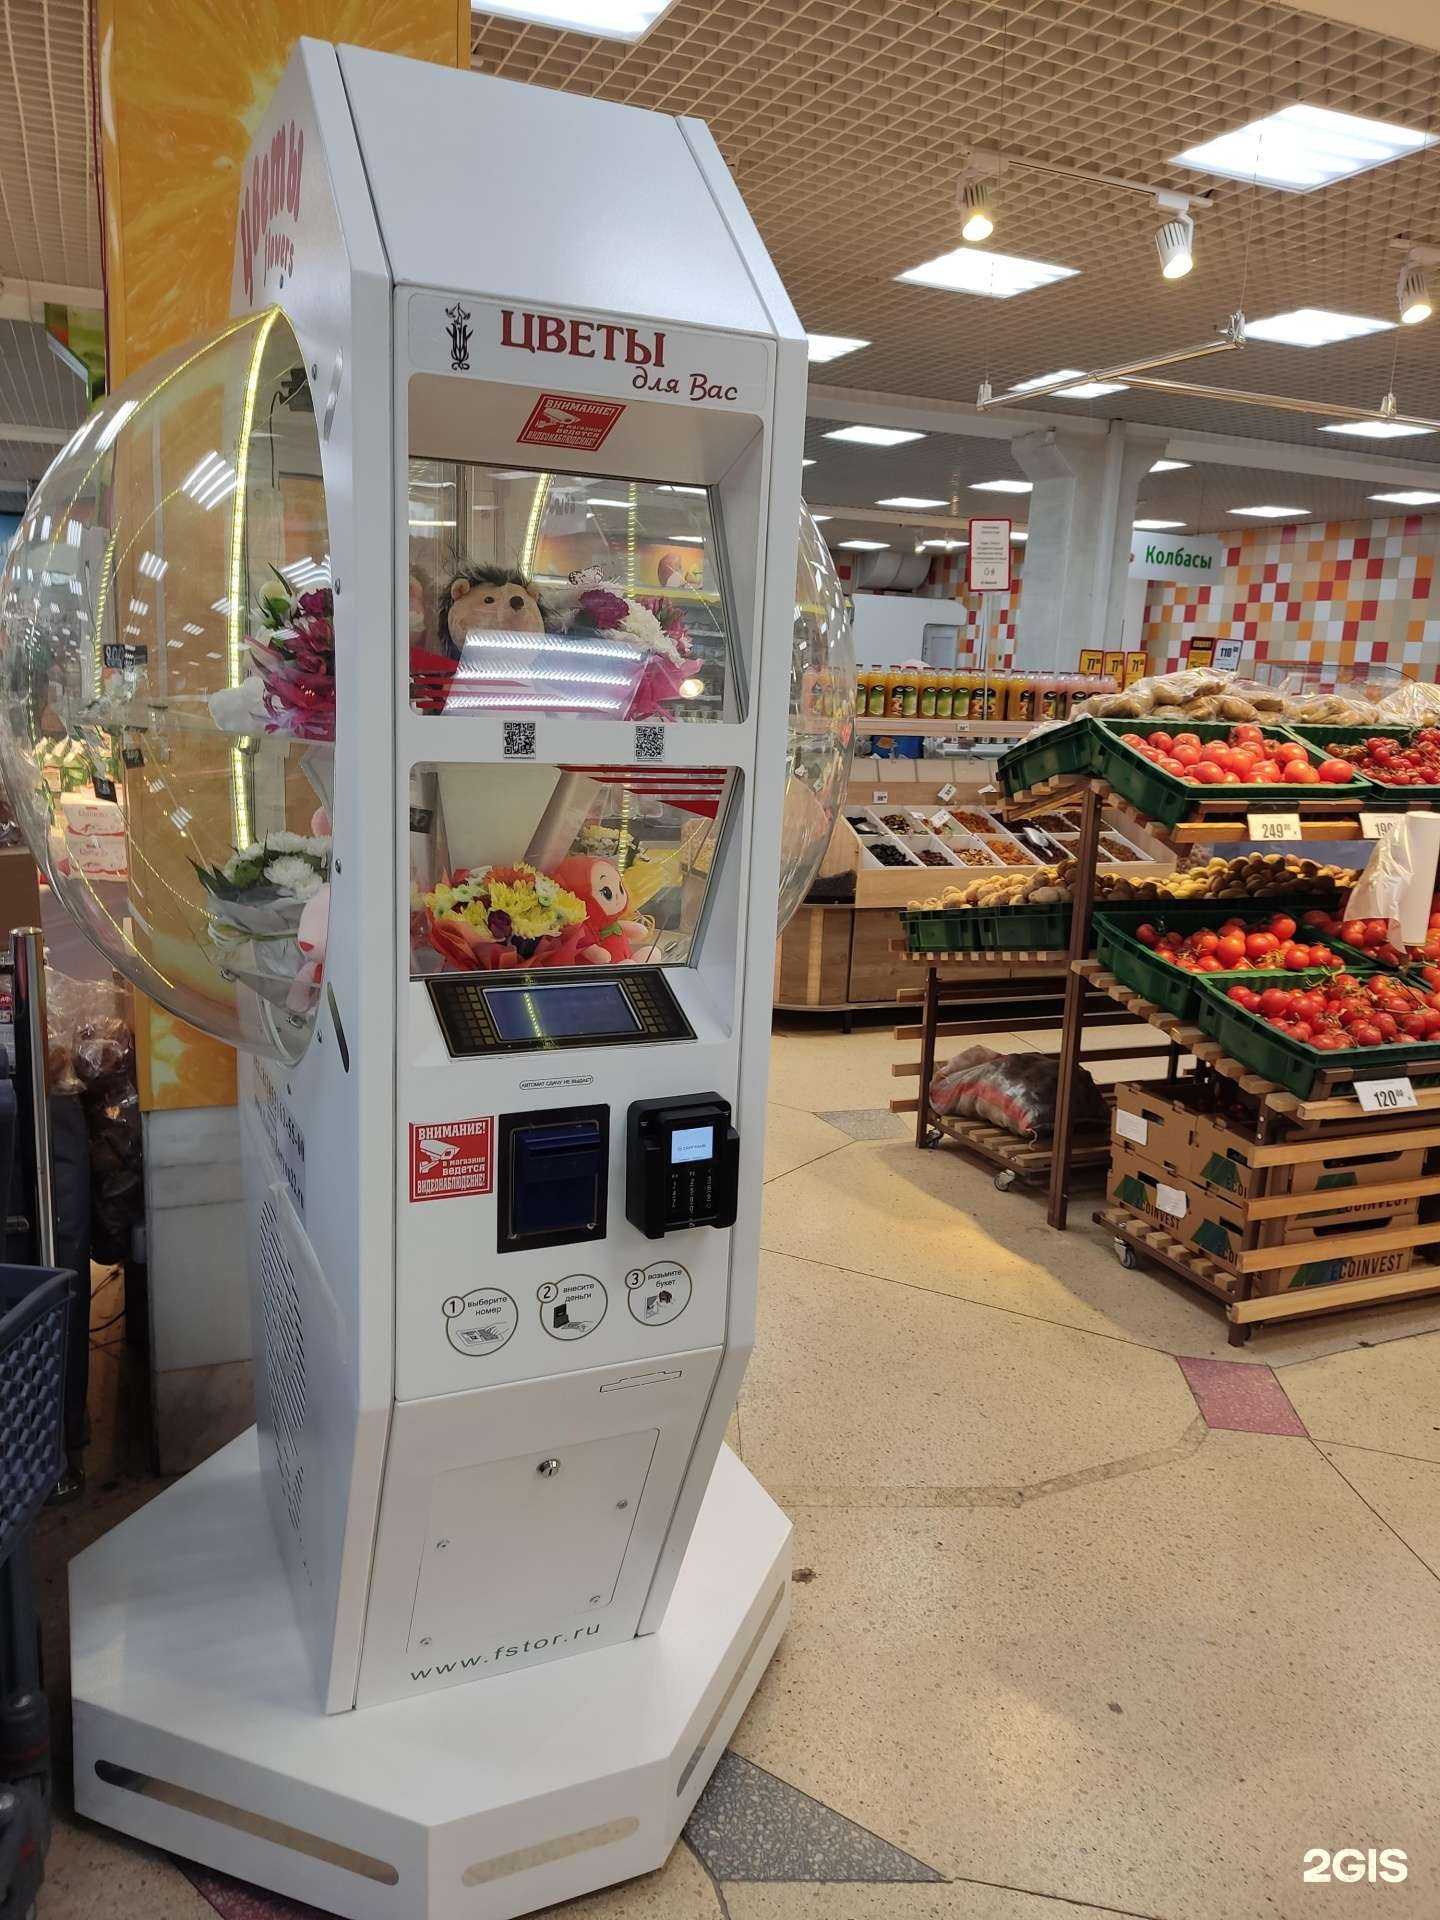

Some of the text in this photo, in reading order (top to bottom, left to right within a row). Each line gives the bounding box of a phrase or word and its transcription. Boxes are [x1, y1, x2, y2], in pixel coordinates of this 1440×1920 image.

[500, 309, 666, 367] ЦВЕТЫ
[632, 365, 738, 401] для Вас
[544, 399, 615, 416] ВНИМАНИЕ!
[1145, 545, 1212, 569] Колбасы
[1374, 1089, 1397, 1108] 120
[418, 1121, 486, 1140] ВНИМАНИЕ!
[449, 1157, 486, 1166] магазине
[442, 1164, 486, 1176] ведется
[417, 1174, 486, 1195] ВИДЕОНАБЛЮДЕНИЕ!
[1330, 1253, 1404, 1281] ECOINVEST
[631, 1272, 639, 1285] 3
[655, 1279, 676, 1289] букет
[543, 1286, 551, 1299] 2
[563, 1283, 595, 1294] внесите
[467, 1295, 508, 1309] выберите
[565, 1292, 592, 1303] деньги
[475, 1306, 502, 1317] номер
[409, 1623, 600, 1681] www.fstor.ru
